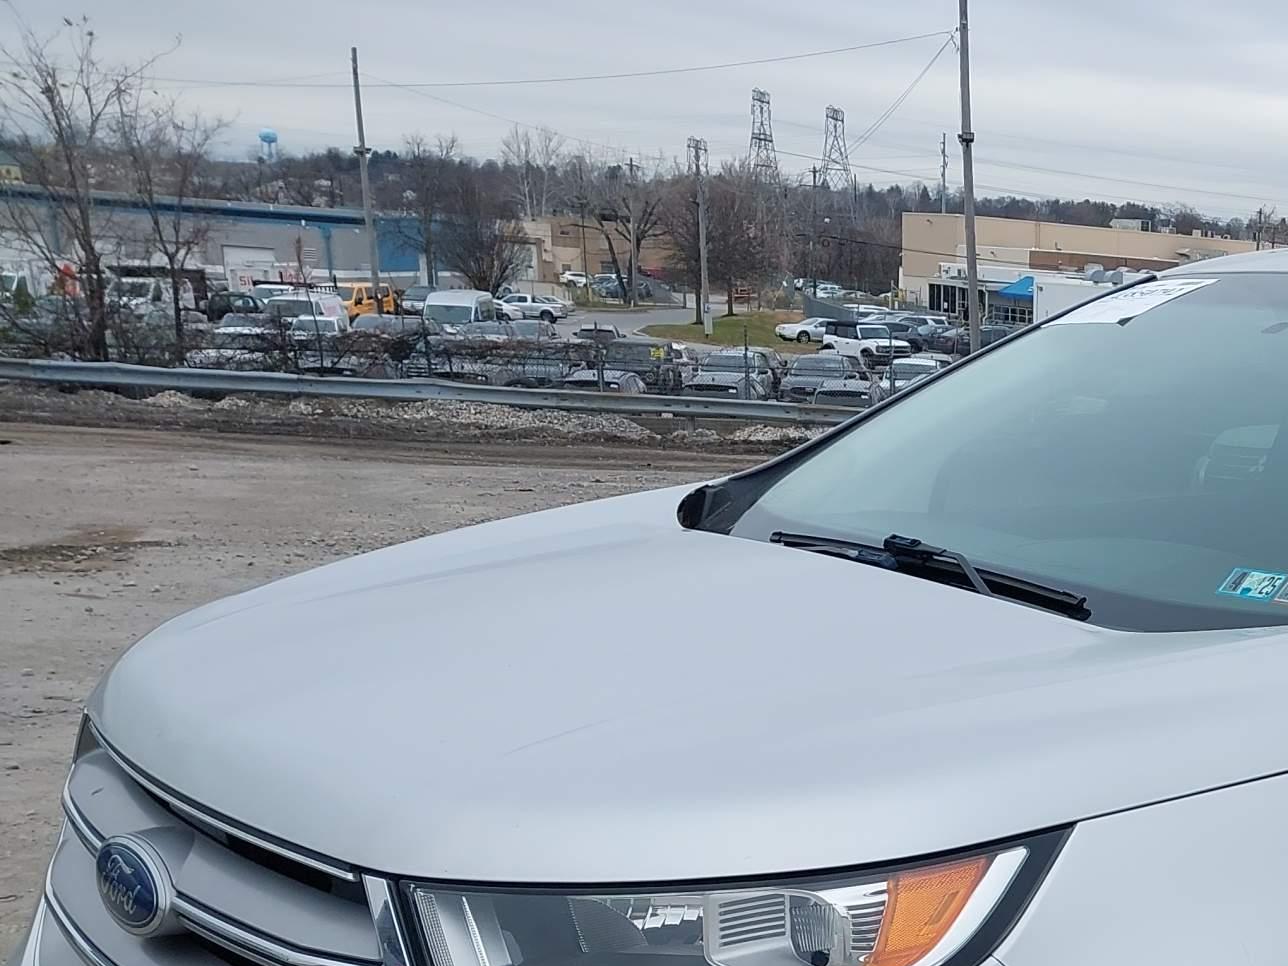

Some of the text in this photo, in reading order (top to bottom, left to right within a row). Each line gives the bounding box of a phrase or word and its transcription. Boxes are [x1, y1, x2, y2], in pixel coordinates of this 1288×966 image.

[1229, 572, 1283, 596] 4 25
[100, 854, 141, 915] Ford
